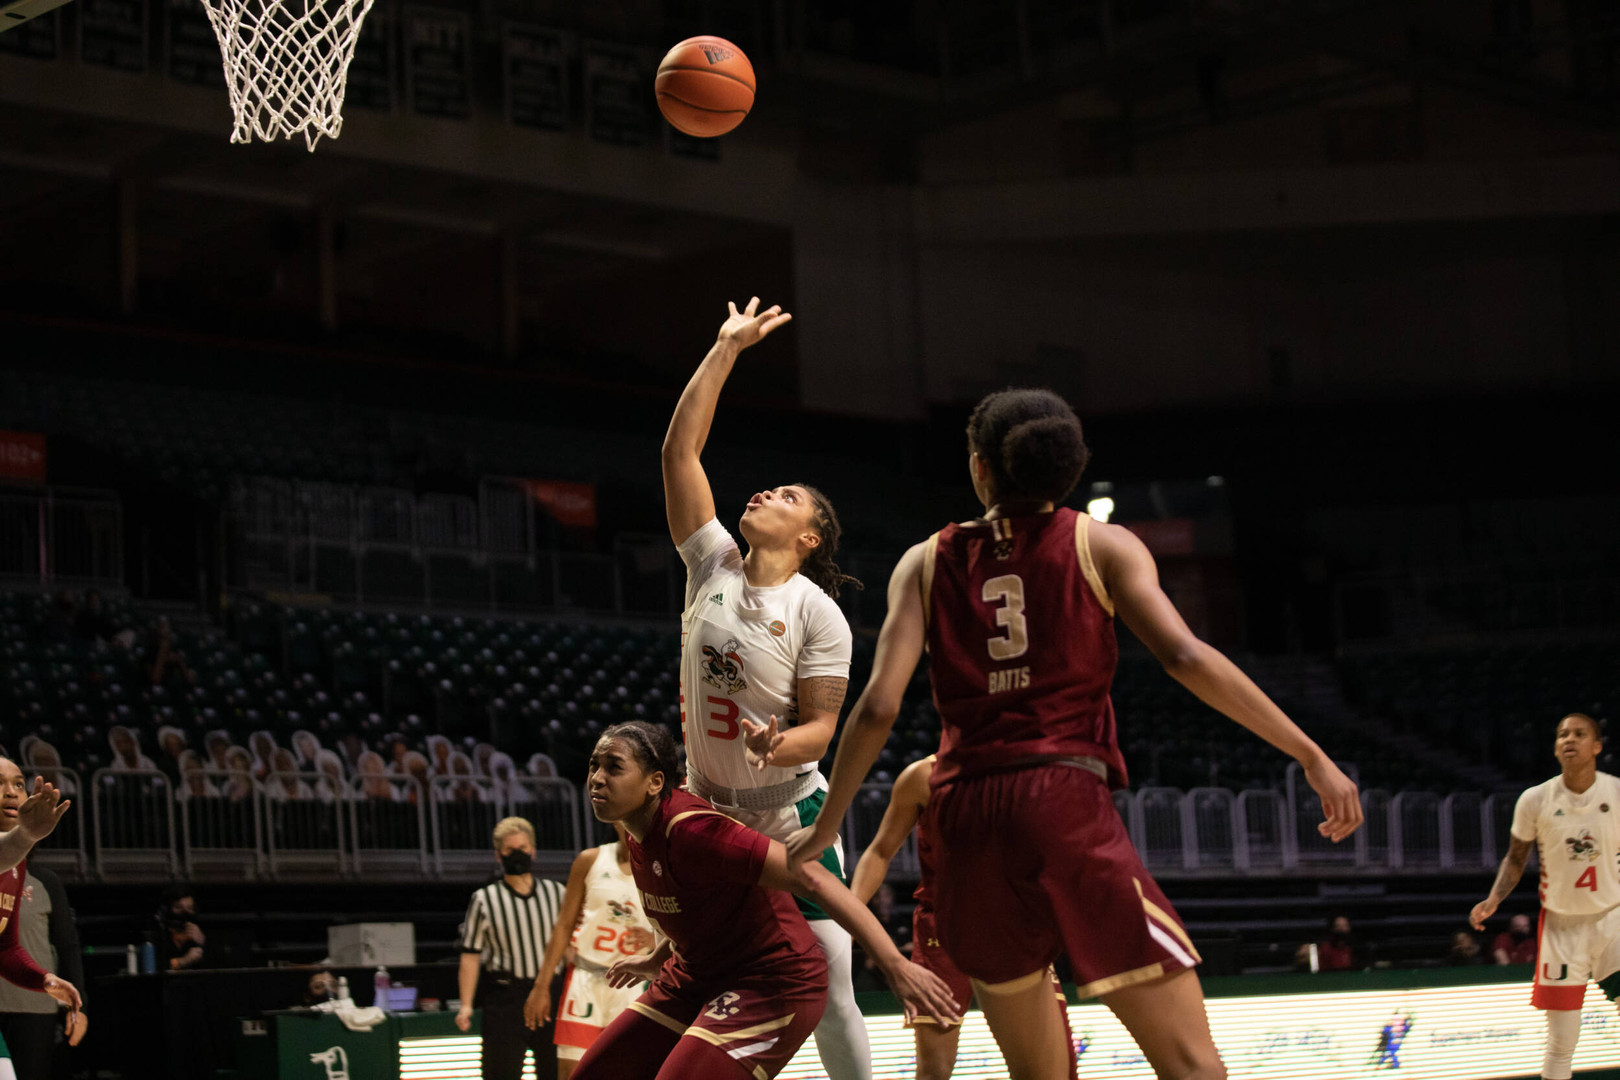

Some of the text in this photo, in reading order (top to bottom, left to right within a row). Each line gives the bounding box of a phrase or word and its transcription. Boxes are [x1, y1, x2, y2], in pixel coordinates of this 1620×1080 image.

[981, 574, 1029, 661] 3
[988, 666, 1031, 695] BATTS
[707, 695, 740, 740] 3
[1574, 866, 1598, 892] 4
[645, 892, 682, 914] COLLEGE
